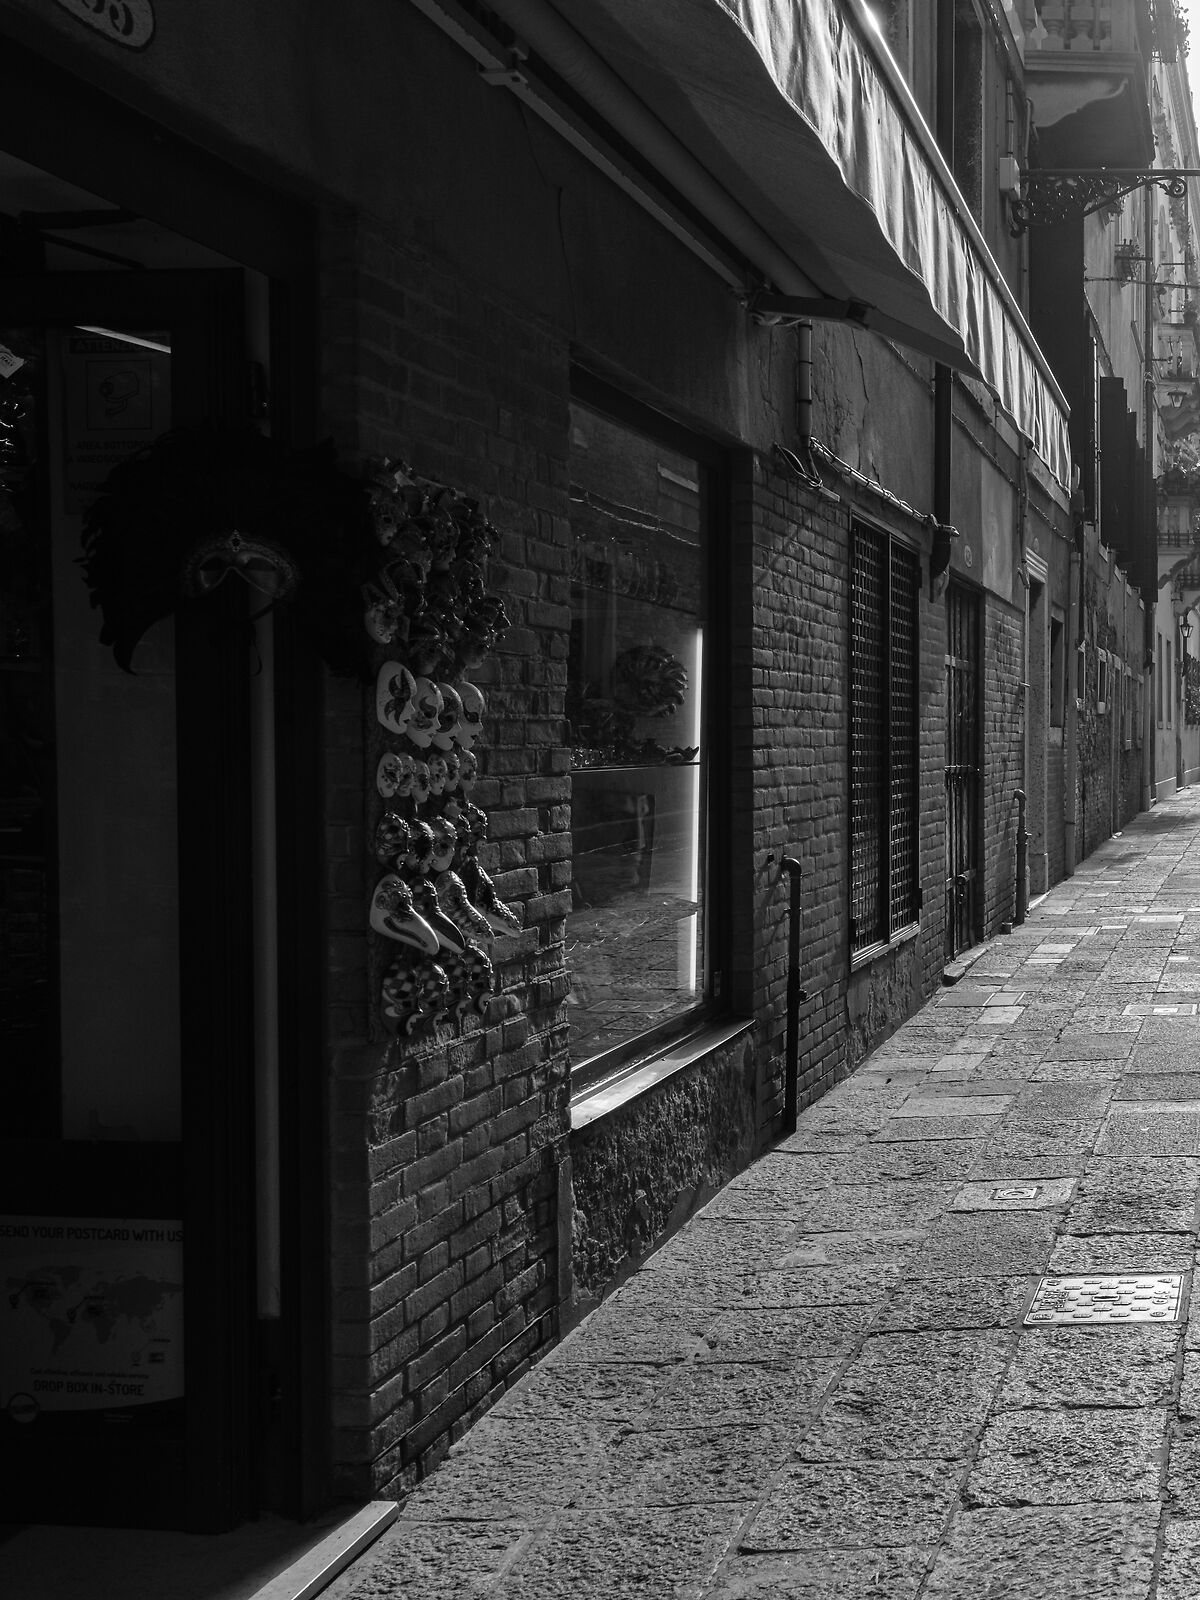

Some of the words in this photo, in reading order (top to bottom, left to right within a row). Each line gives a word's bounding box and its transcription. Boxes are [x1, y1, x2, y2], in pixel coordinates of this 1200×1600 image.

[0, 1225, 29, 1238] SEND
[31, 1226, 64, 1239] YOUR
[67, 1228, 130, 1241] POSTCARD
[132, 1229, 165, 1242] WITH
[167, 1230, 184, 1242] US
[33, 1379, 64, 1393] DROP
[66, 1380, 89, 1393] BOX
[91, 1382, 145, 1397] IN-STORE
